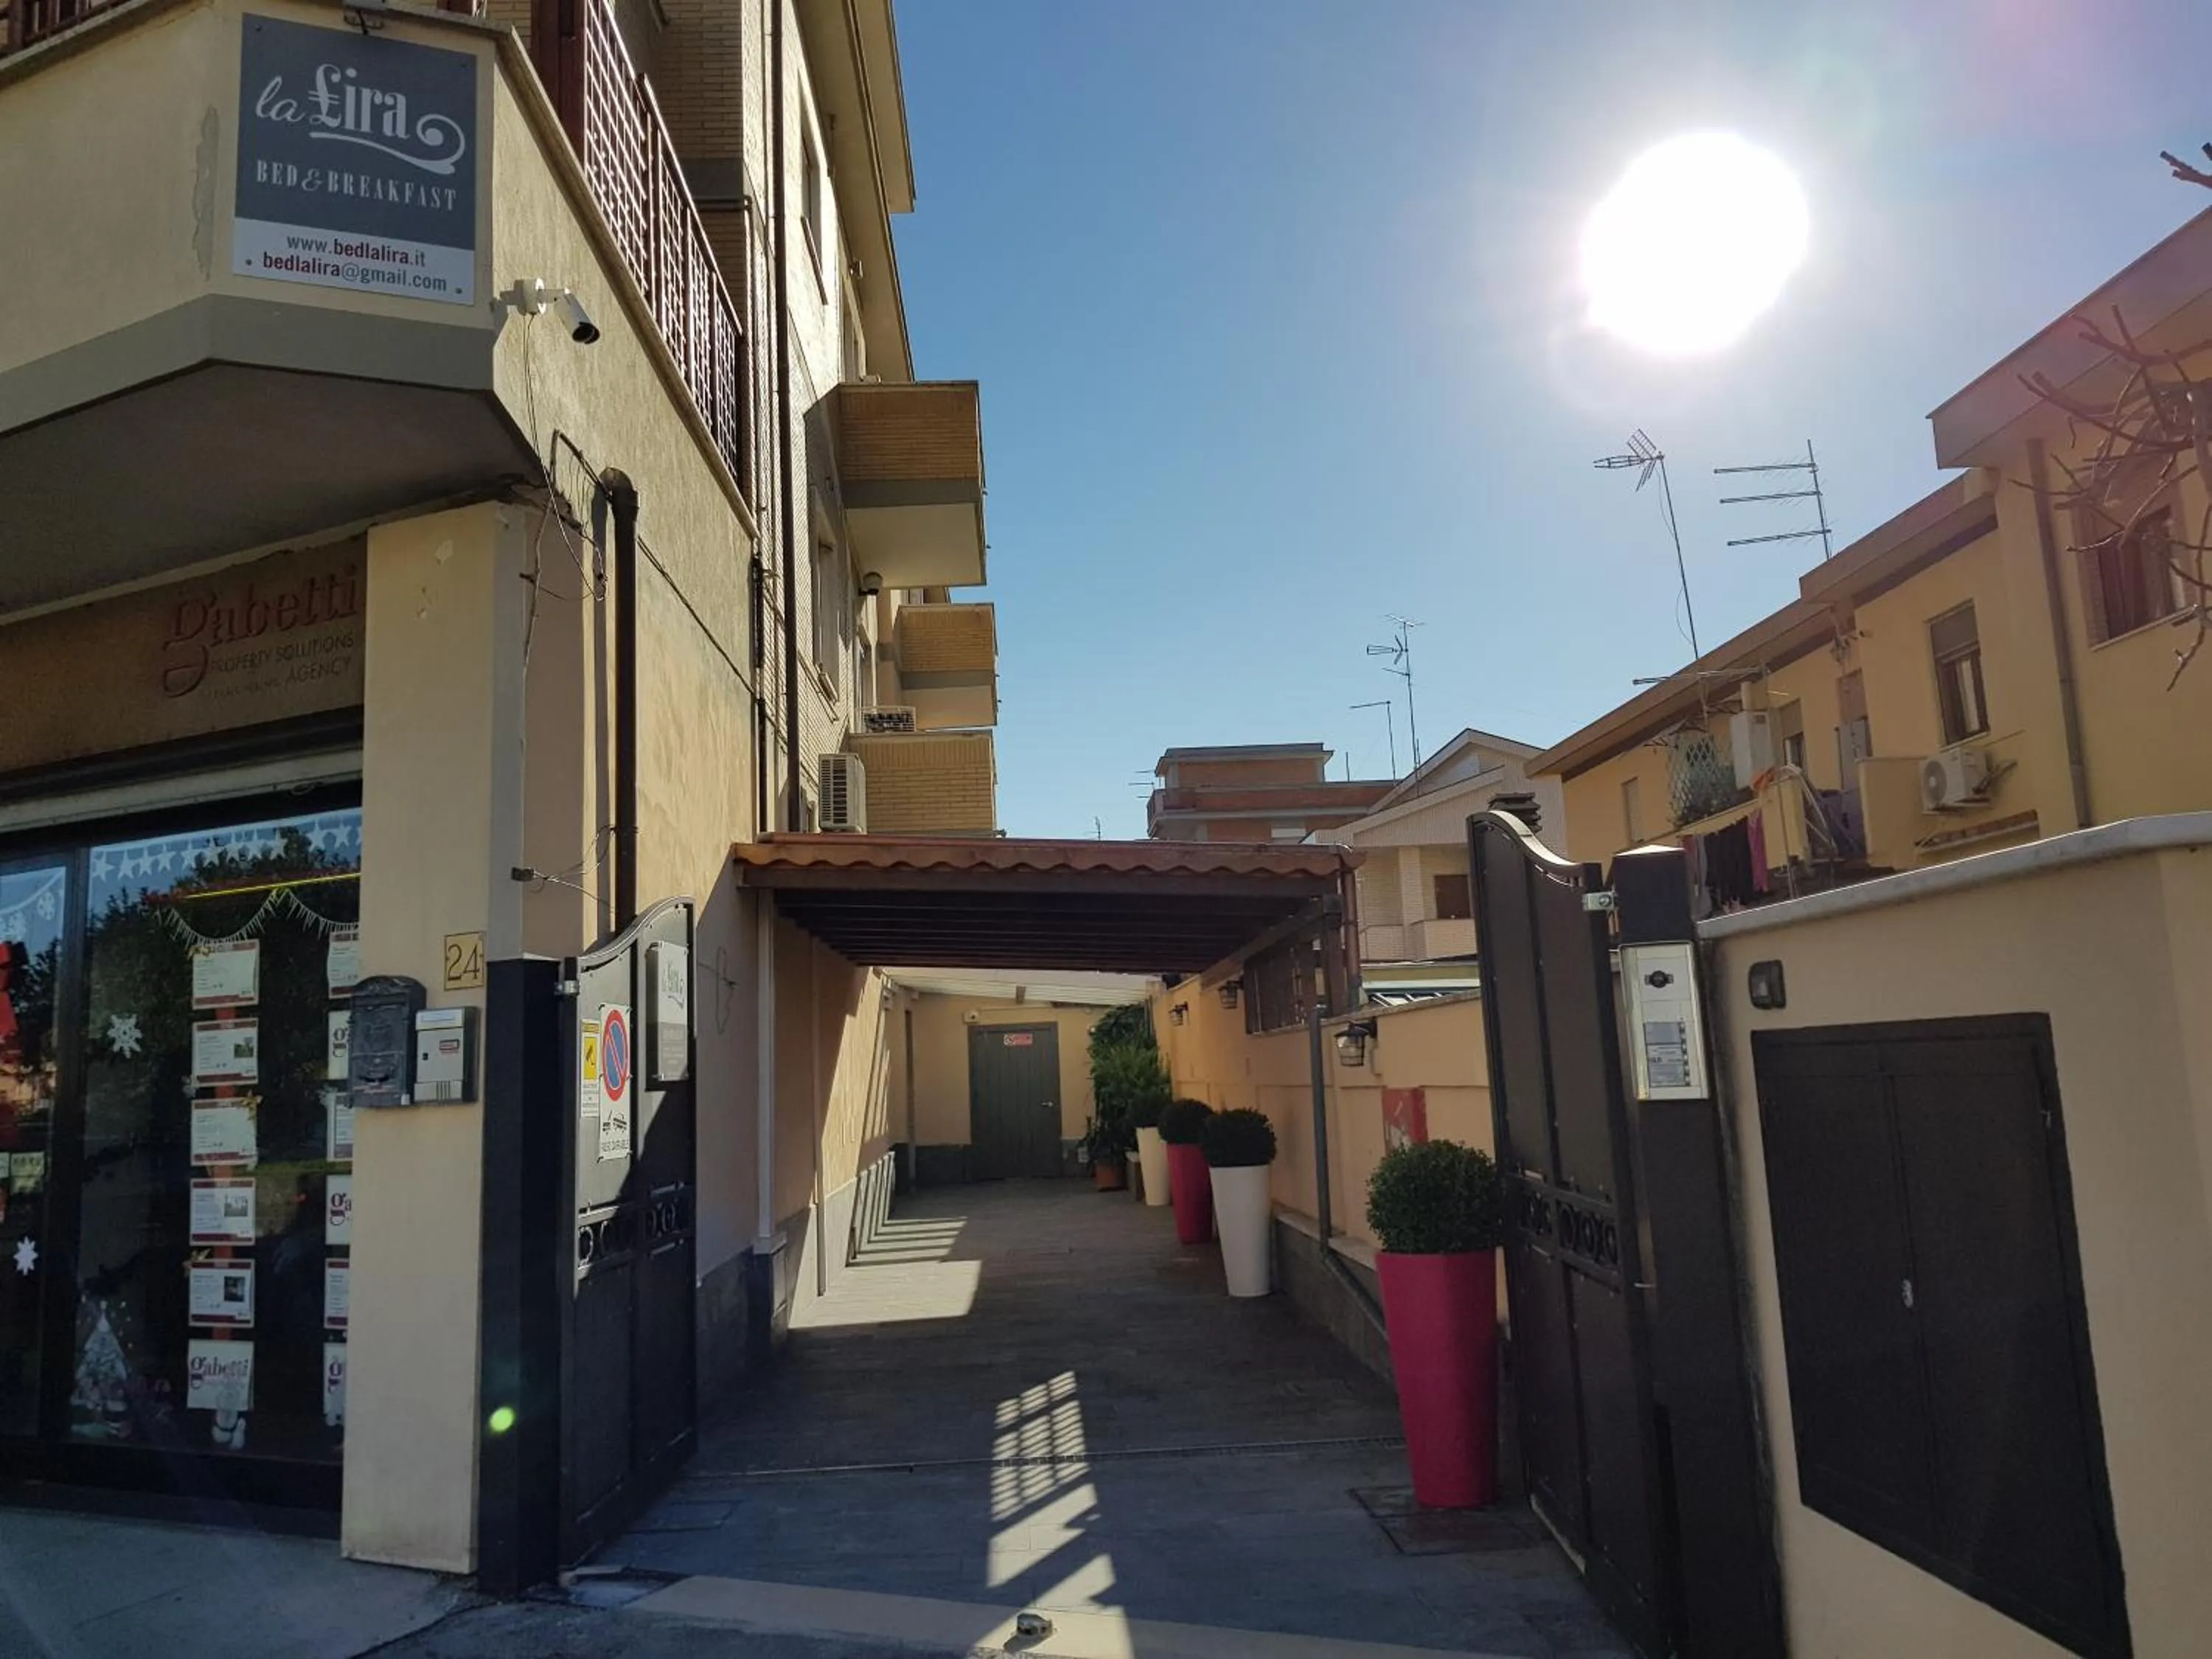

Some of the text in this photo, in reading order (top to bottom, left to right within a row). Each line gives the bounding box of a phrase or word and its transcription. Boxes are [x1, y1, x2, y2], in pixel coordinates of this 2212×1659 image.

[255, 76, 305, 122] la
[262, 251, 448, 292] bedlalira@gmail.com
[287, 234, 425, 268] www.bedlalira.it
[162, 563, 358, 698] gabetti
[447, 943, 480, 981] 24
